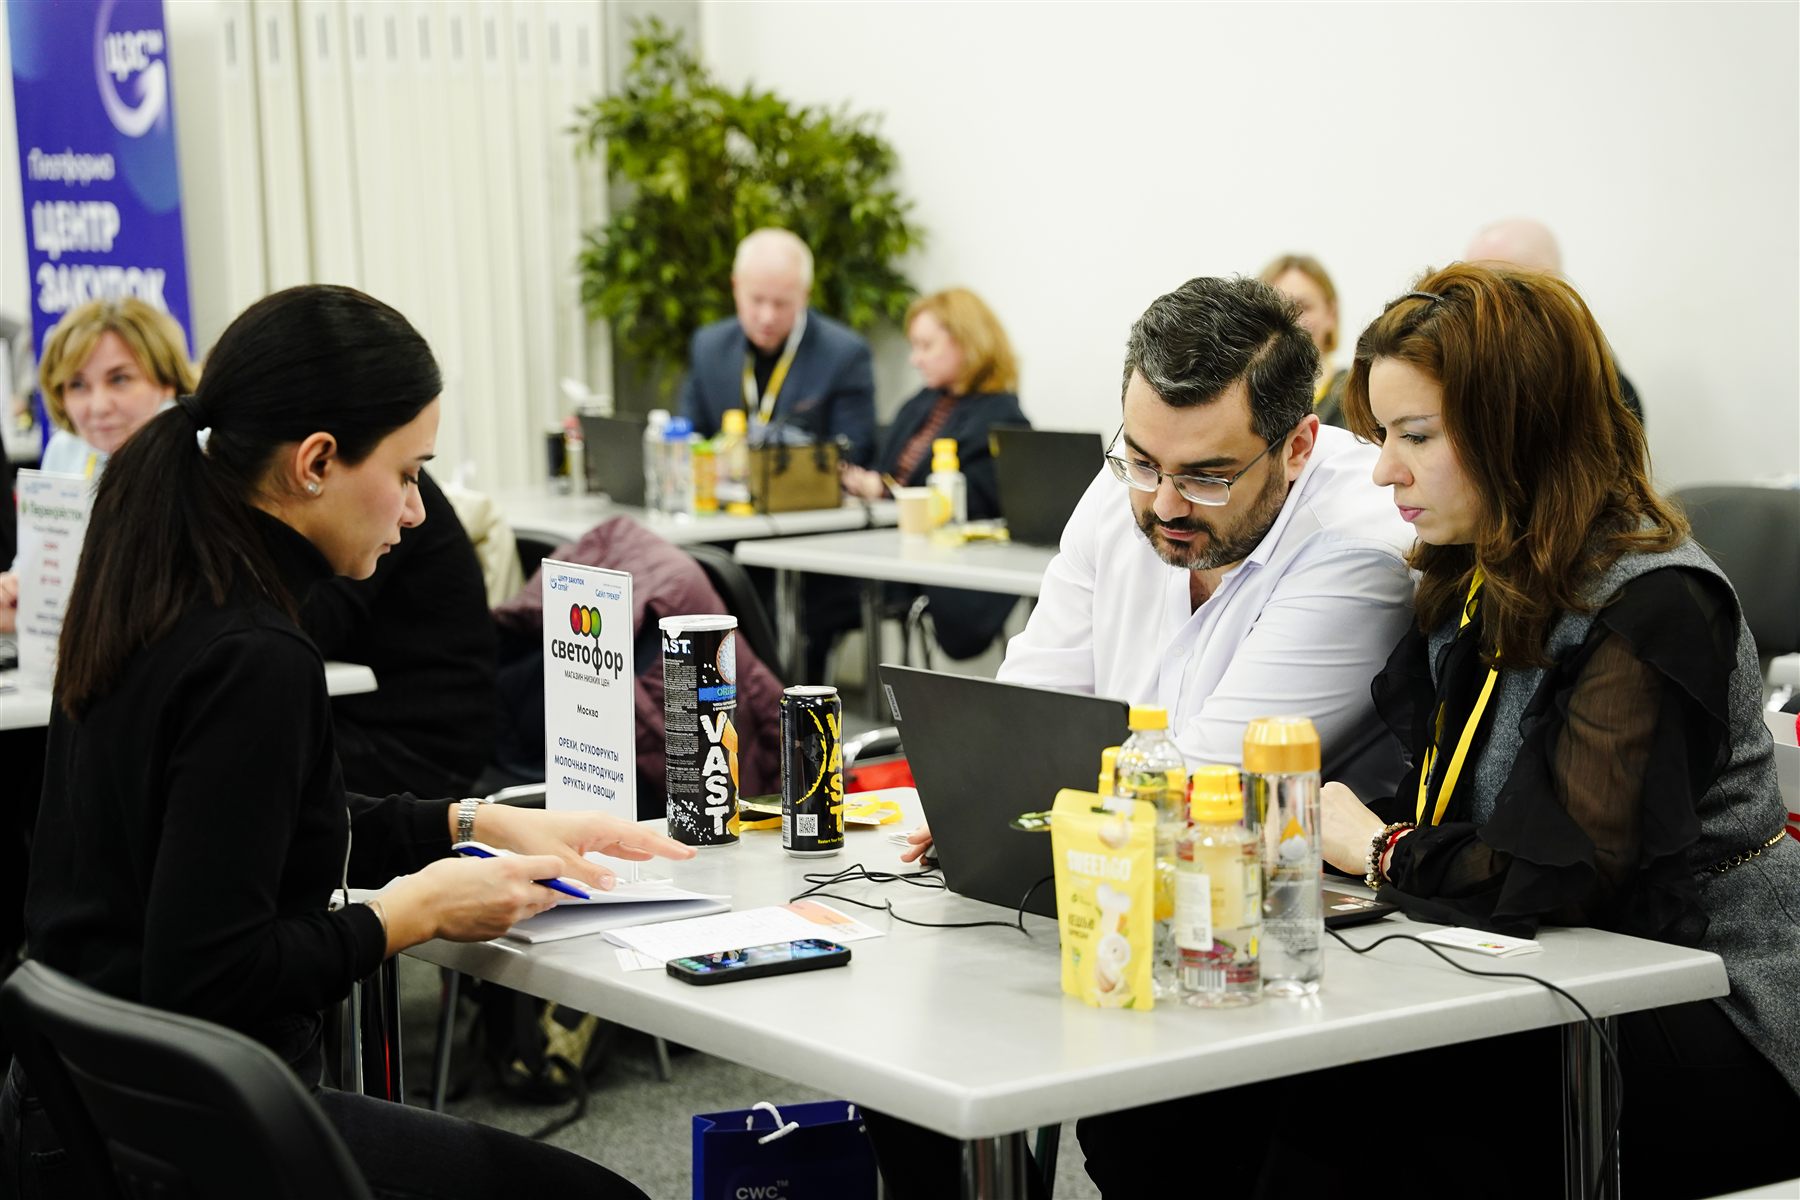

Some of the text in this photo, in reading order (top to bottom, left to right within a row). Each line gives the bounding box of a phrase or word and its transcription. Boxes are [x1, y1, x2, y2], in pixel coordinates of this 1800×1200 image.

[32, 199, 121, 261] ЦЕНТР
[551, 638, 623, 680] светофор
[564, 670, 610, 687] МАГАЗИН НИЗКИХ ЦЕН
[577, 705, 598, 718] Москва
[558, 736, 619, 762] ОРЕХИ, СУХОФРУКТЫ
[554, 754, 624, 783] МОЛОЧНАЯ ПРОДУКЦИЯ
[562, 775, 615, 800] ФРУКТЫ И ОВОЩИ
